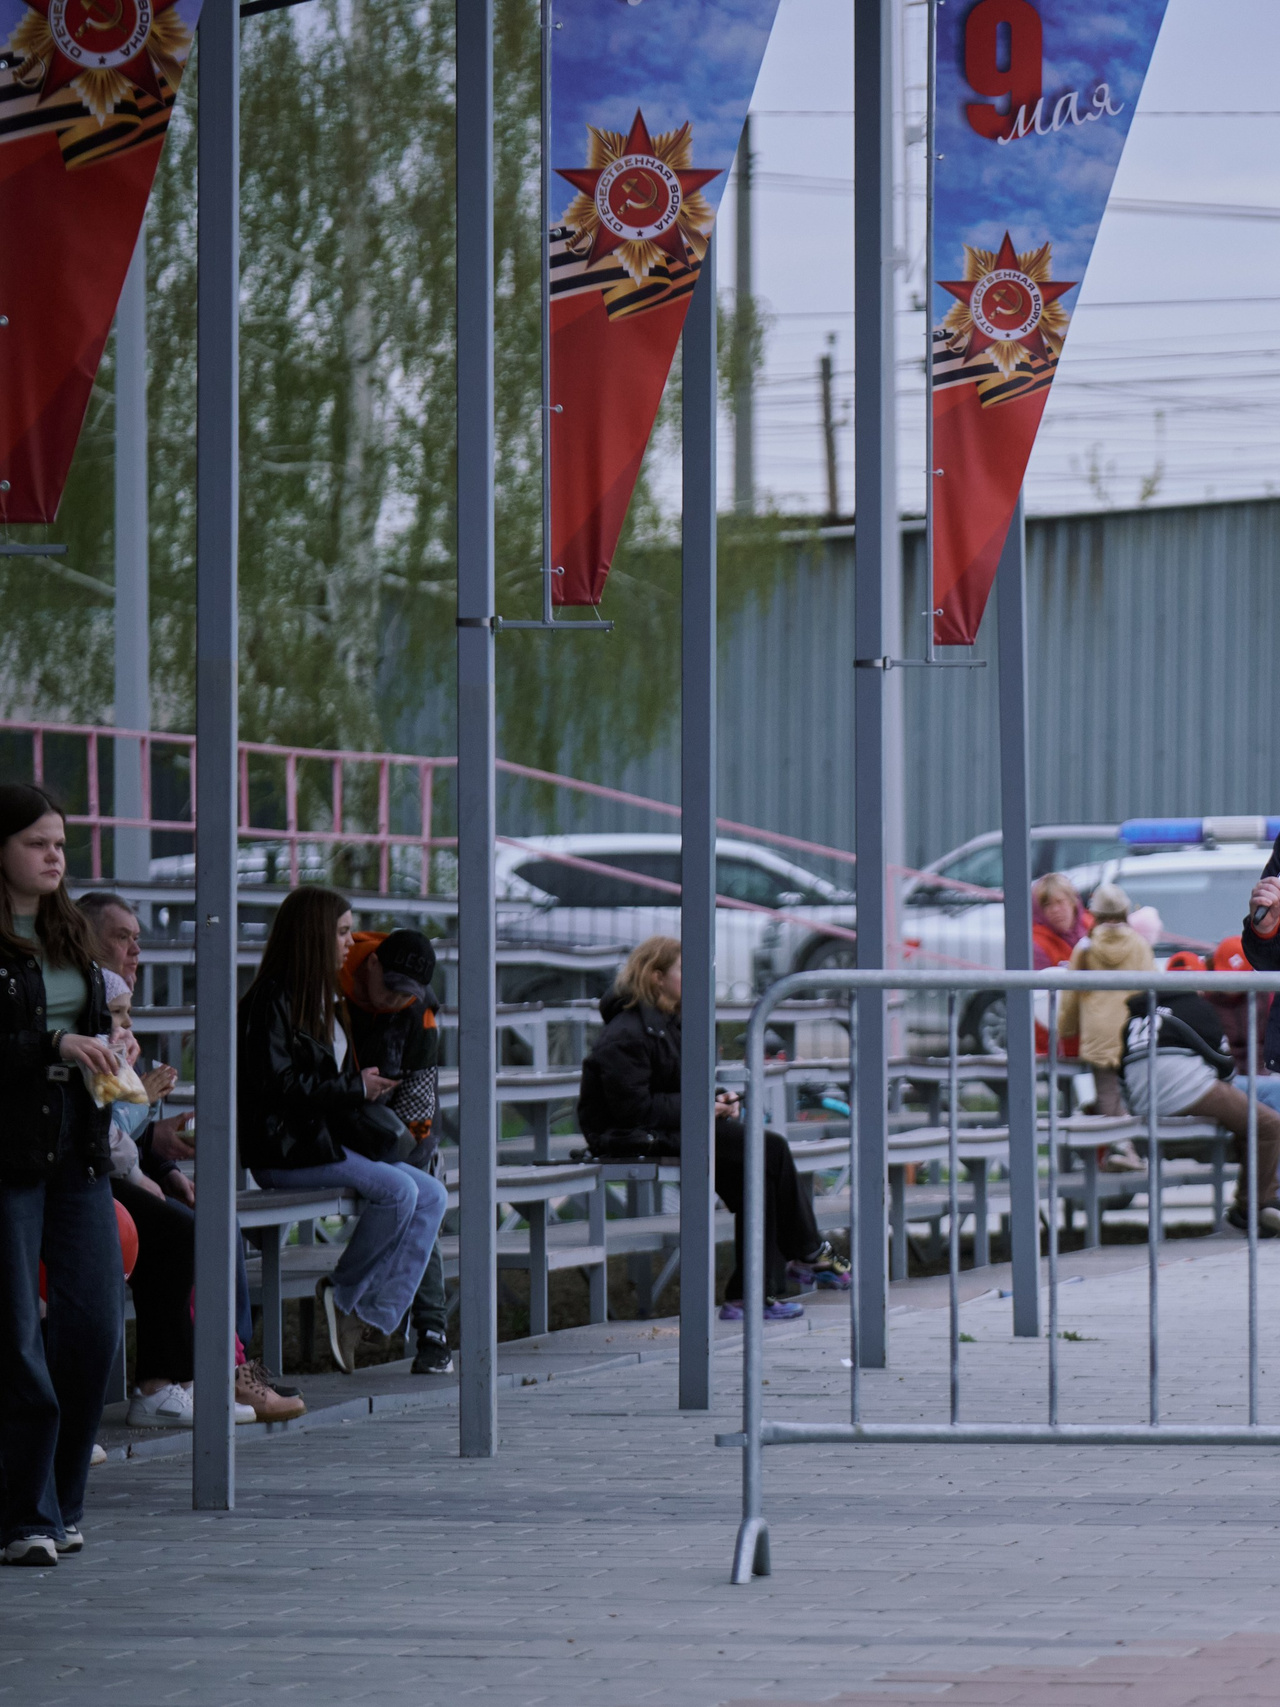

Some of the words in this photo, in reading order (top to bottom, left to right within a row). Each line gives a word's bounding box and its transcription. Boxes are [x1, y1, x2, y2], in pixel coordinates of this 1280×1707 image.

[965, 0, 1042, 140] 9
[997, 83, 1125, 145] мая
[599, 157, 673, 232] ОТЕЧЕСТВЕННАЯ
[974, 272, 1036, 334] ОТЕЧЕСТВЕННАЯ
